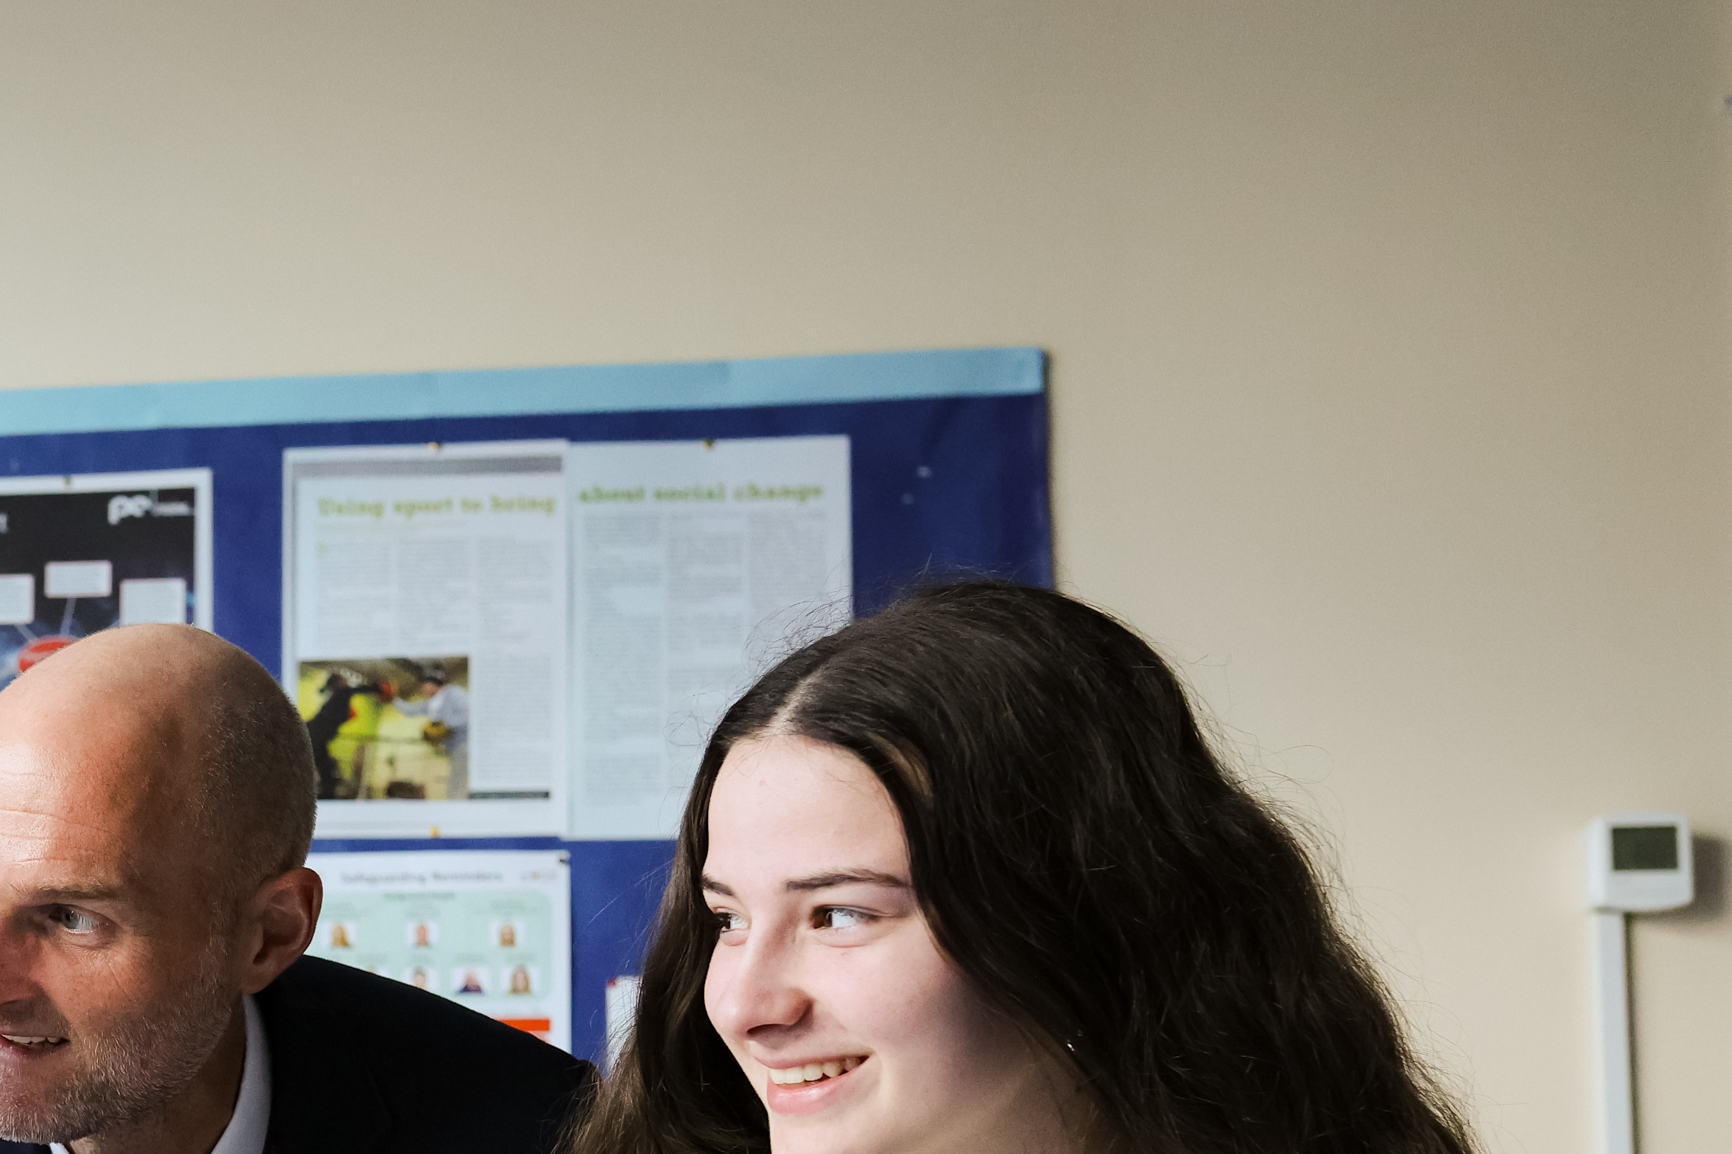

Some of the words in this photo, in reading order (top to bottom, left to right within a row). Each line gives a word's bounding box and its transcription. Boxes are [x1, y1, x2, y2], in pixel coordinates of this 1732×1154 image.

[318, 498, 385, 519] Using
[393, 500, 454, 519] sport
[460, 498, 483, 514] to
[579, 484, 646, 503] about
[653, 482, 727, 503] social
[732, 482, 825, 503] change
